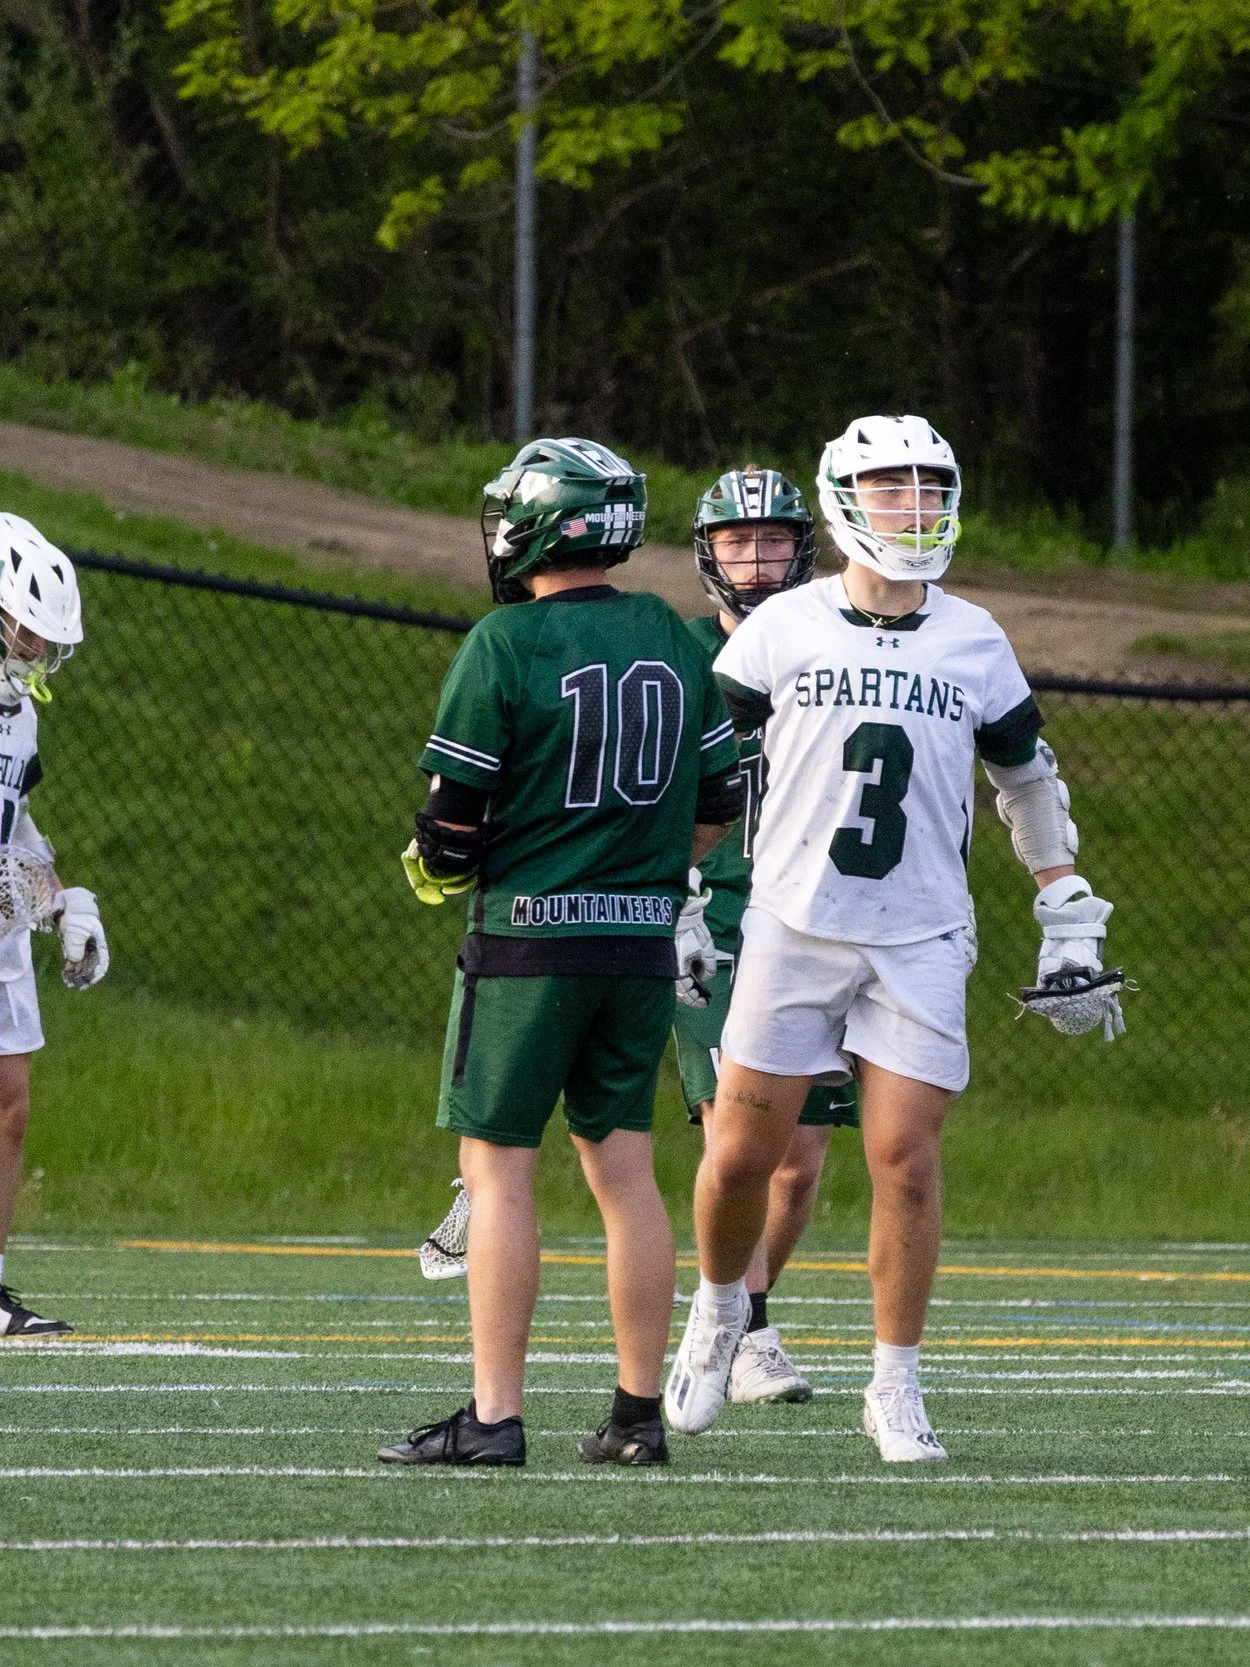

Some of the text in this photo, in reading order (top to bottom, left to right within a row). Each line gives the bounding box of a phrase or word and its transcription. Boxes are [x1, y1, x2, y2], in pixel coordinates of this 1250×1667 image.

[560, 660, 685, 809] 10
[795, 667, 966, 722] SPARTANS
[828, 721, 915, 881] 3
[511, 893, 673, 926] MOUNTAINEERS
